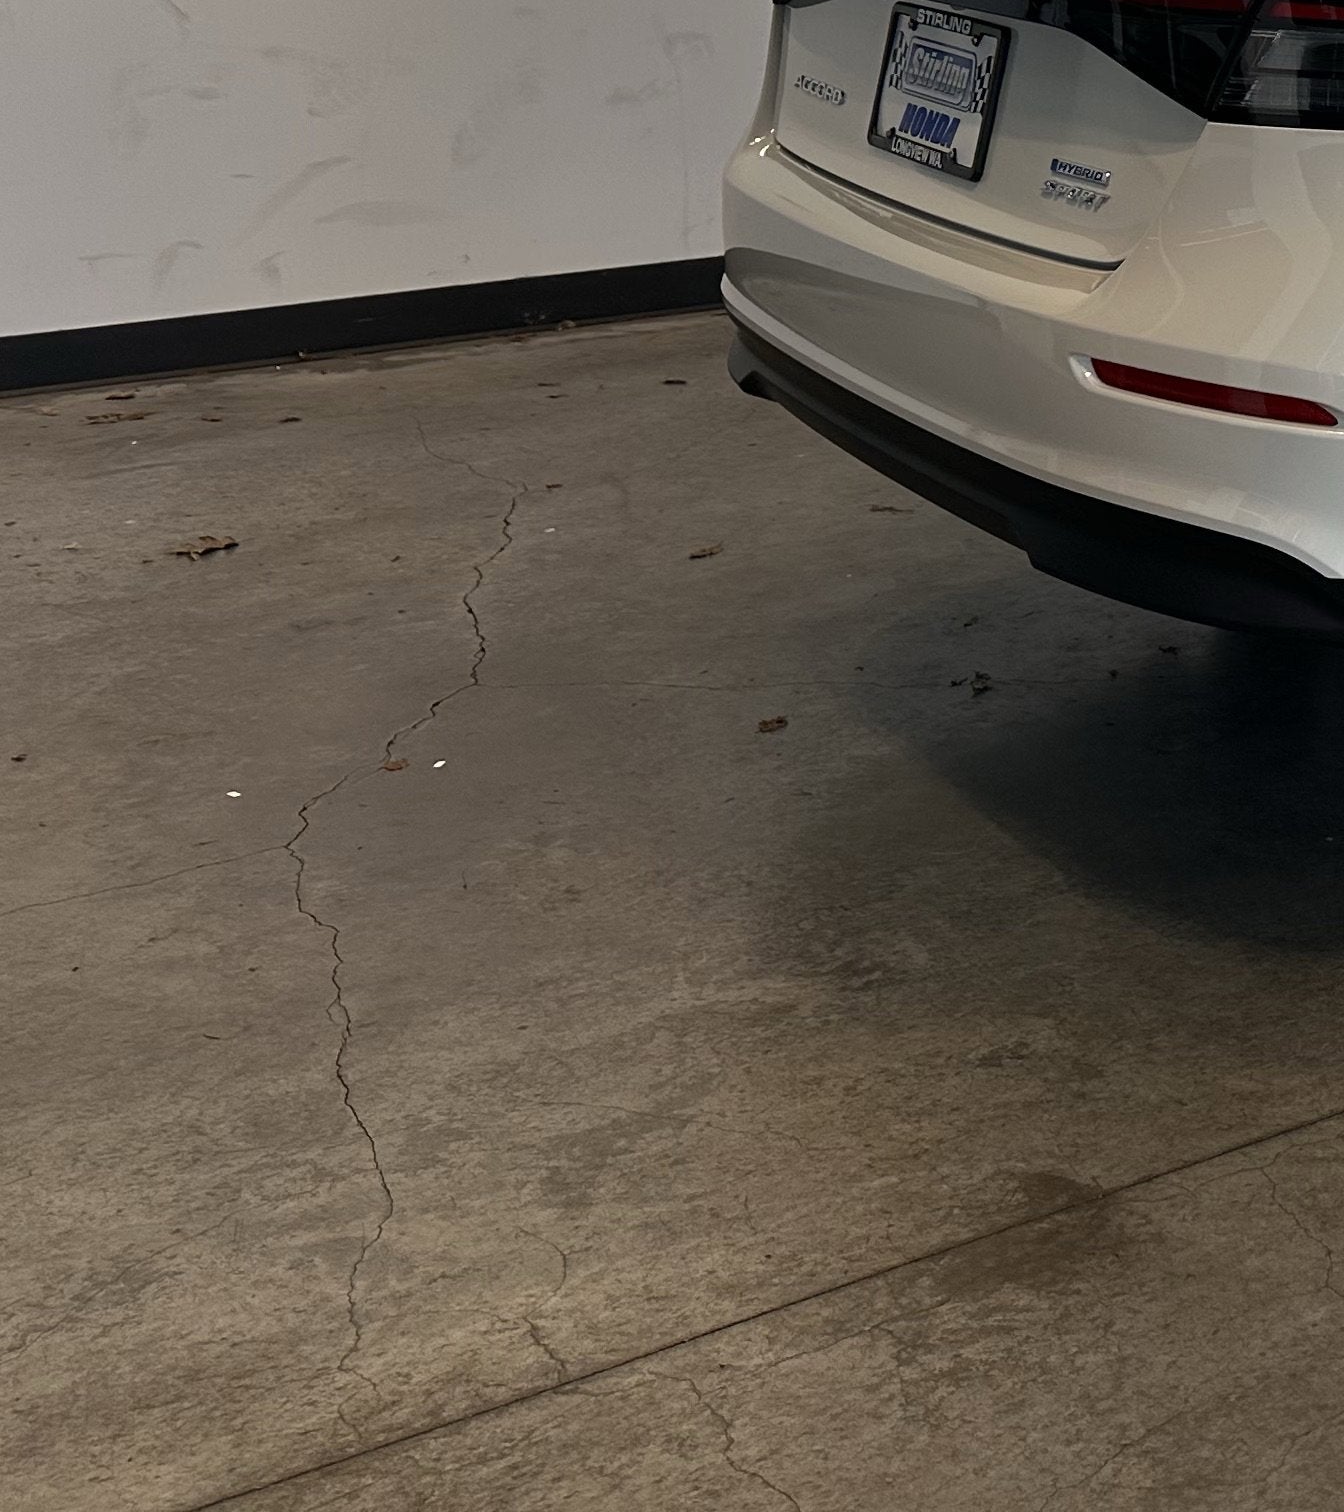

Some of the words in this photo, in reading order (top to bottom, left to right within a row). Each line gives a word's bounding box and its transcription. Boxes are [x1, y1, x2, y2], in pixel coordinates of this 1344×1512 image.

[917, 8, 972, 34] STIRLING
[794, 75, 845, 105] ACCORD
[898, 102, 961, 148] HONDA
[891, 138, 930, 162] LONGVIEW
[1057, 161, 1104, 181] HYBRID
[1043, 180, 1111, 212] SPORT
